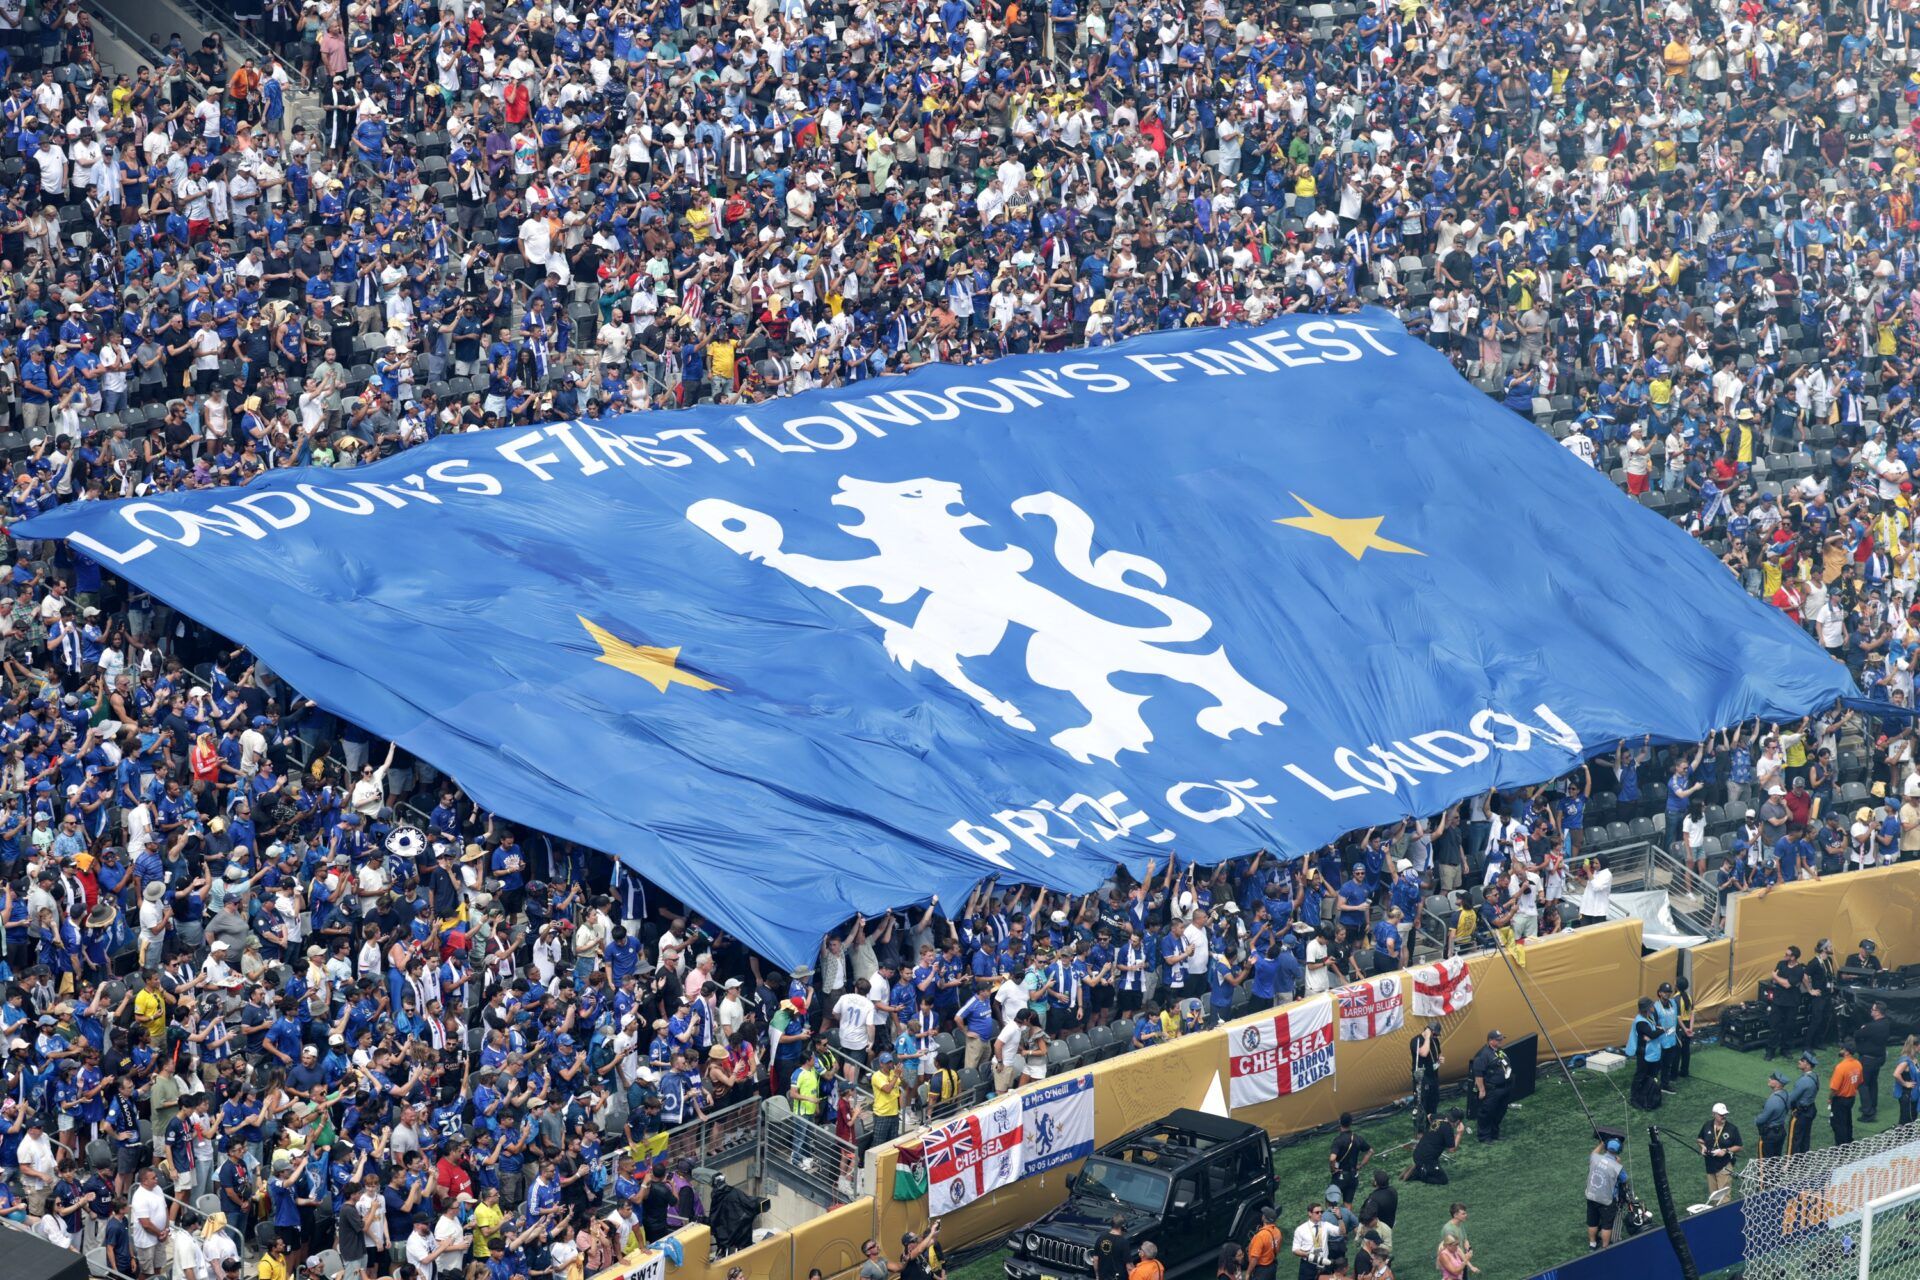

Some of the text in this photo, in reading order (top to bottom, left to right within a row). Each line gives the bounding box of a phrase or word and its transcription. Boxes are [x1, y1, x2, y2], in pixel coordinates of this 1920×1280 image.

[495, 419, 756, 481] FIRST,
[735, 362, 1131, 454] LONDON'S
[1125, 318, 1398, 383] FINEST
[1579, 441, 1591, 456] 19
[1165, 777, 1278, 824] OF
[1283, 702, 1584, 801] LONDON
[1239, 1029, 1327, 1075] CHELSEA
[1292, 1043, 1334, 1075] BARROW
[1298, 1060, 1331, 1089] BLUES
[955, 1137, 1004, 1172] CHELSEA
[1047, 1152, 1073, 1166] London
[630, 1261, 659, 1280] SW17
